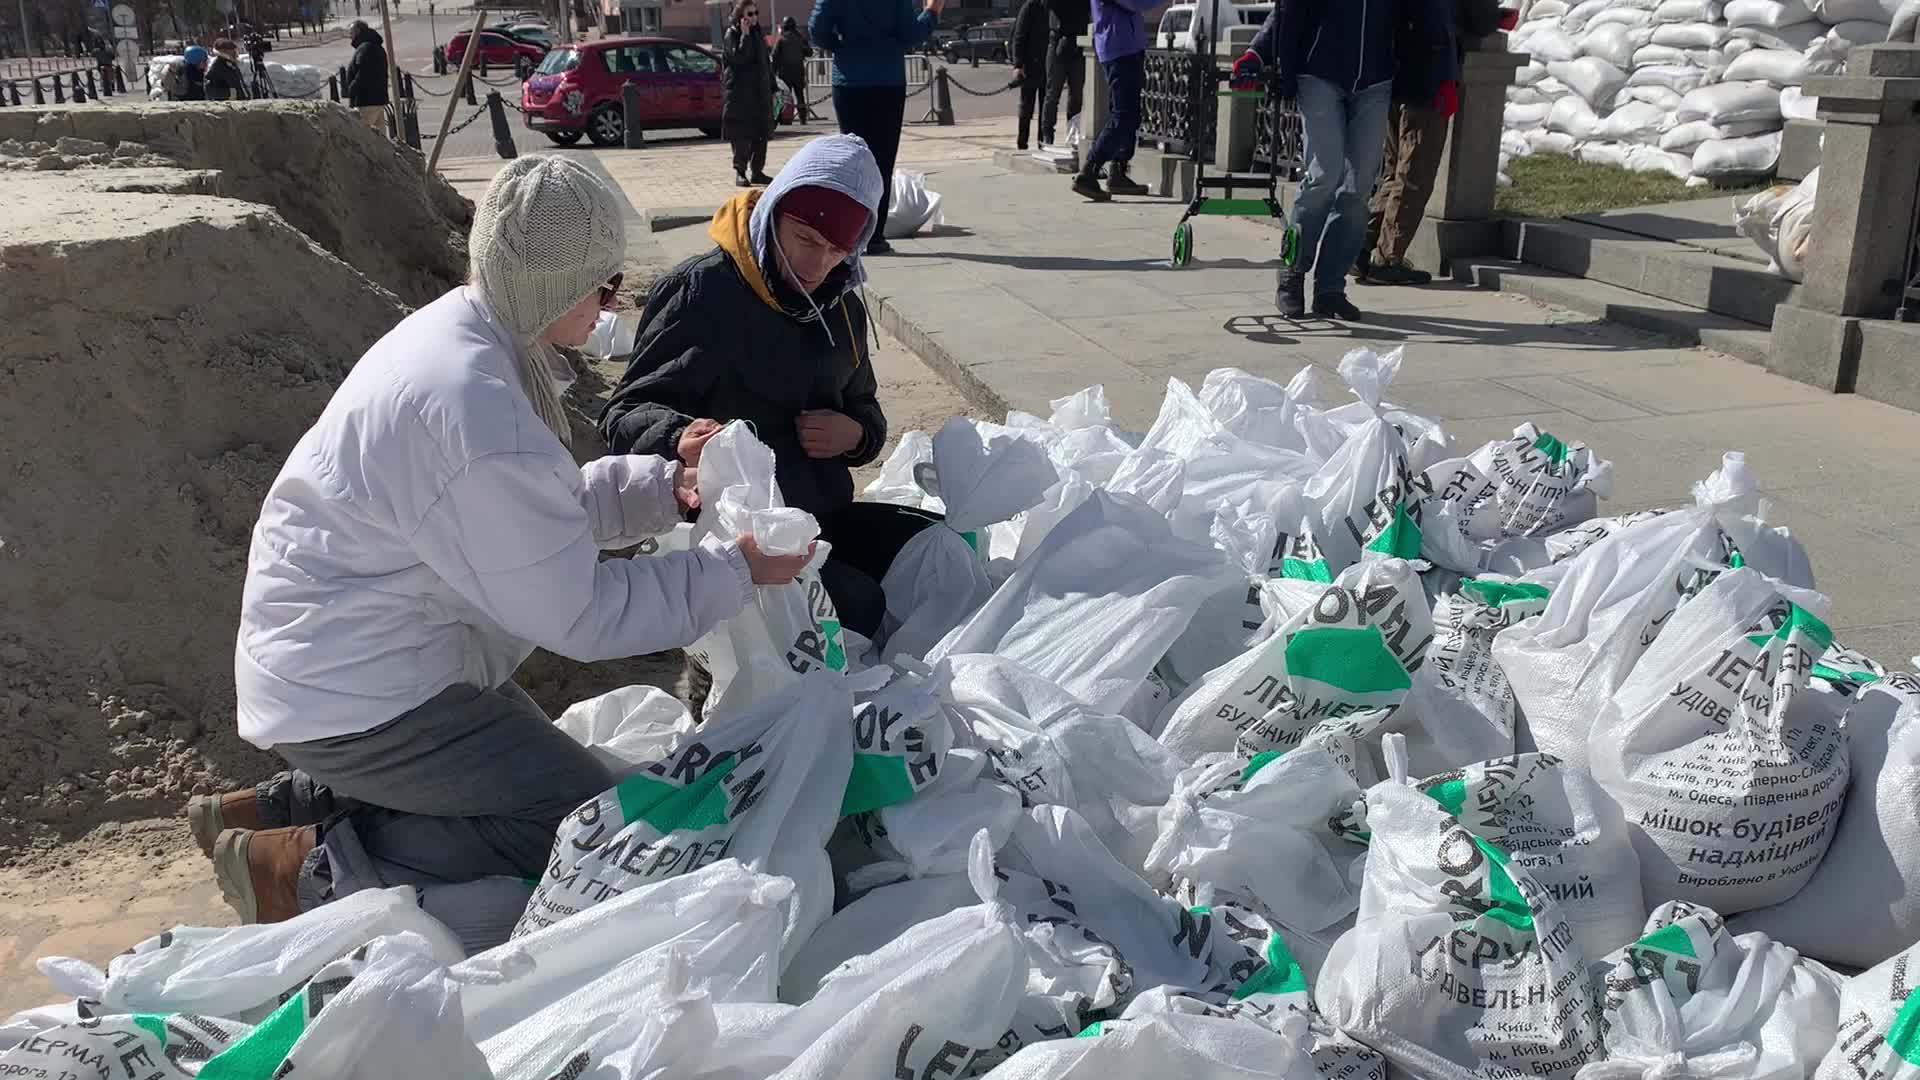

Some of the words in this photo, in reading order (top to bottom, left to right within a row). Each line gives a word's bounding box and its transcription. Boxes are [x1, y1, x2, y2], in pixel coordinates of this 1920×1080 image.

[1518, 795, 1534, 808] 12
[1668, 788, 1683, 799] м.
[1688, 789, 1738, 808] Одеса,
[1743, 787, 1809, 806] Південна
[1640, 808, 1723, 838] мішок
[1687, 821, 1829, 868] надміцний
[1557, 853, 1564, 865] 1
[1678, 873, 1764, 887] Вироблено
[1489, 1051, 1508, 1061] м.
[1511, 1043, 1554, 1057] Київ,
[1559, 1025, 1583, 1050] вул.
[1318, 1060, 1335, 1073] м.
